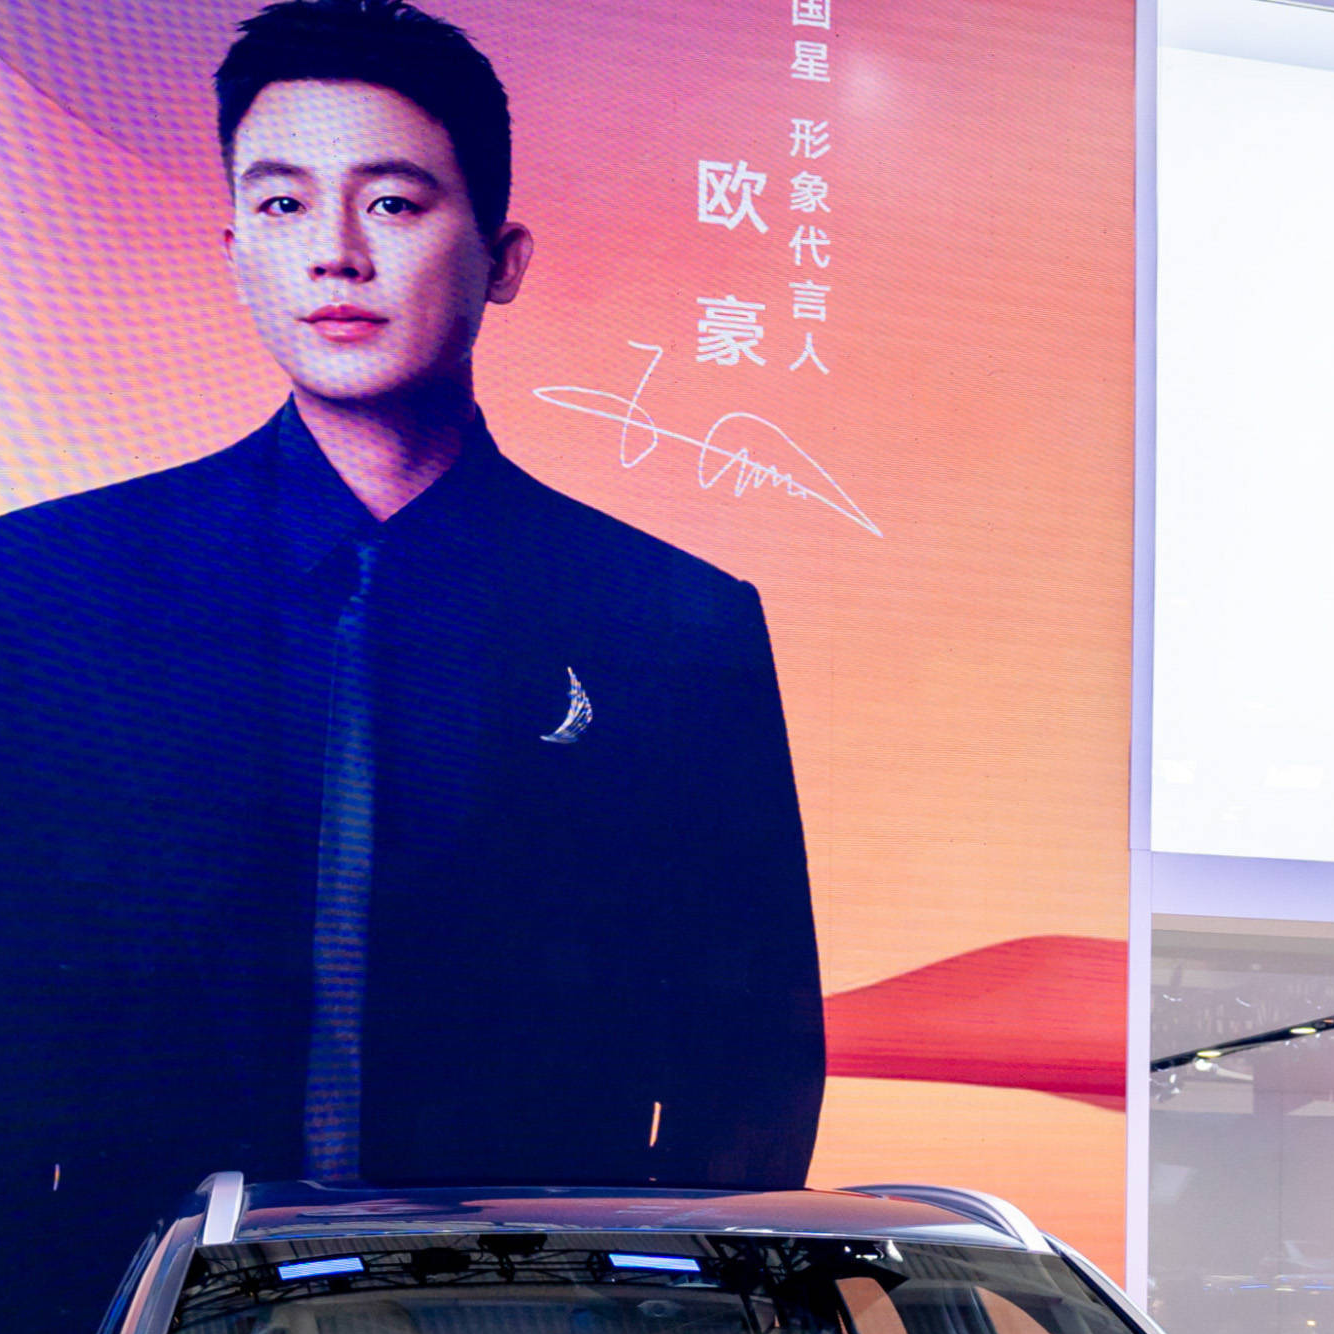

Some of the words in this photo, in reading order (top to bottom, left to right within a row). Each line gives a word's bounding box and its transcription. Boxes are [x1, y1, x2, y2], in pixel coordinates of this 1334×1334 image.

[789, 118, 831, 375] 形象代言人
